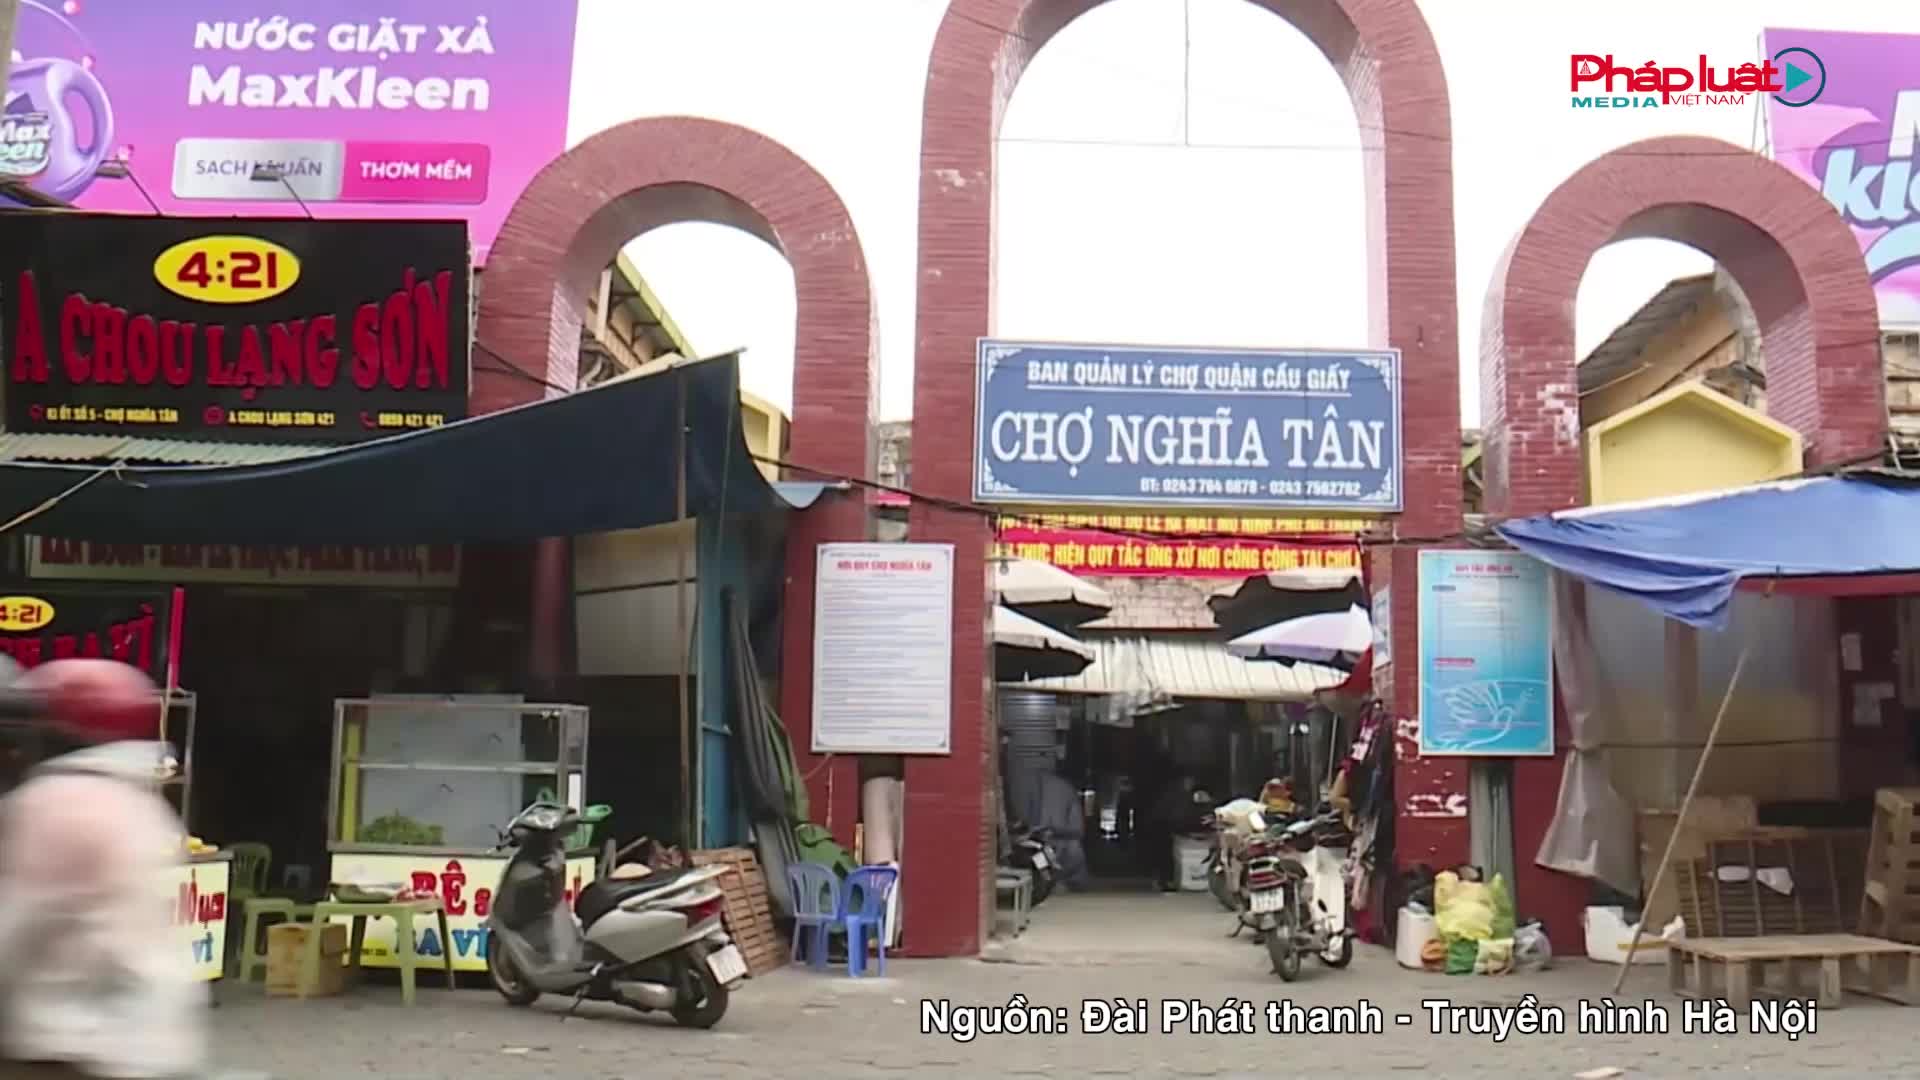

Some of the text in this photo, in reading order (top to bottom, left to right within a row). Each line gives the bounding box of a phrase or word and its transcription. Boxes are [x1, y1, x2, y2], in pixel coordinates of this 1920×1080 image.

[194, 15, 495, 61] NƯỚC GIẶT XẢ
[187, 64, 490, 111] MaxKleen
[360, 159, 420, 179] THƠM
[177, 251, 278, 289] 4:21
[12, 266, 453, 399] A CHOU LẠNG SƠN
[1028, 360, 1067, 384] BAN
[1074, 356, 1126, 385] QUẢN
[1160, 365, 1198, 391] CHỢ
[1204, 361, 1257, 392] QUẬN
[1307, 362, 1350, 391] GIẤY
[991, 404, 1384, 477] CHỢ NGHĨA TÂN
